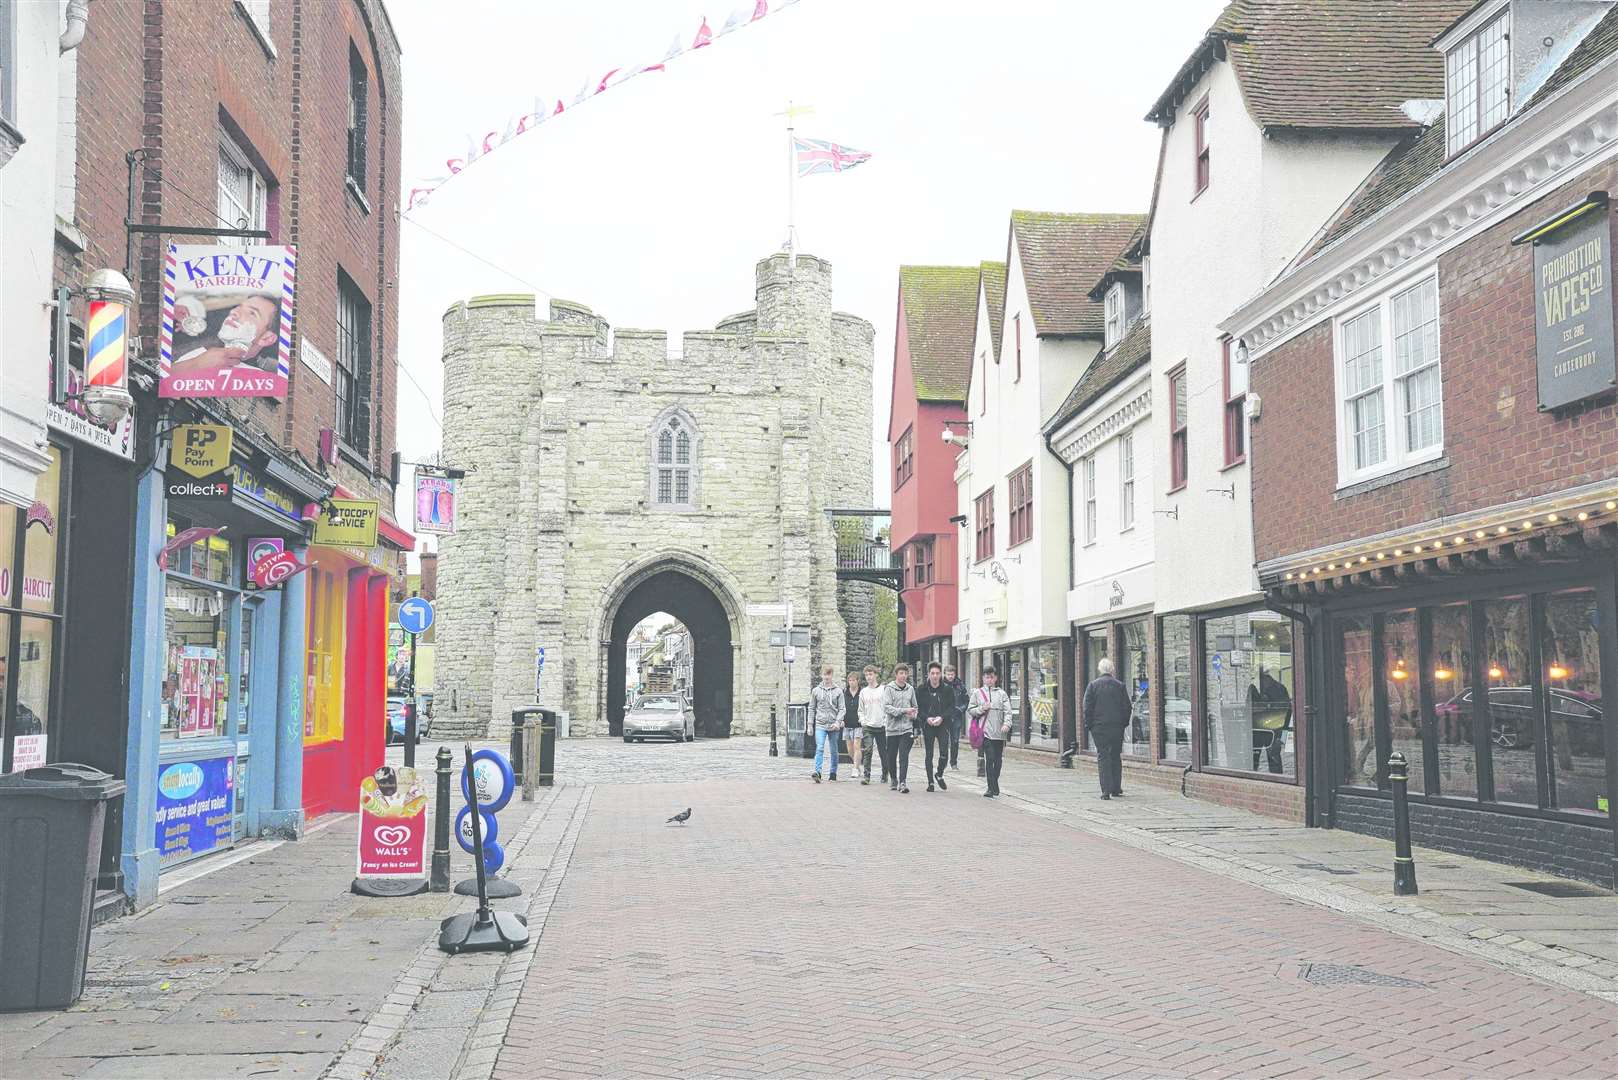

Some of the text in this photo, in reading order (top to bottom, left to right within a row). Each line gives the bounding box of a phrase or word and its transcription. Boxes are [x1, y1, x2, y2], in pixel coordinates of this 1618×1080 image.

[180, 255, 280, 281] KENT
[1542, 237, 1602, 287] PROHIBITION
[194, 276, 265, 289] BARBERS
[1543, 271, 1590, 327] VAPES
[1554, 351, 1597, 378] CANTERBURY
[172, 369, 274, 391] OPEN 7 DAYS
[64, 416, 69, 428] 7
[70, 419, 86, 436] DAYS
[94, 430, 112, 446] WEEK
[184, 457, 214, 467] Point
[185, 448, 205, 458] Pay
[320, 507, 374, 518] PTOCOPY
[257, 552, 286, 574] WALL'S
[23, 576, 51, 598] AIRCUT
[167, 803, 186, 820] service
[187, 800, 197, 815] and
[197, 798, 210, 816] great
[211, 794, 227, 810] value!
[375, 847, 409, 856] WALL'S
